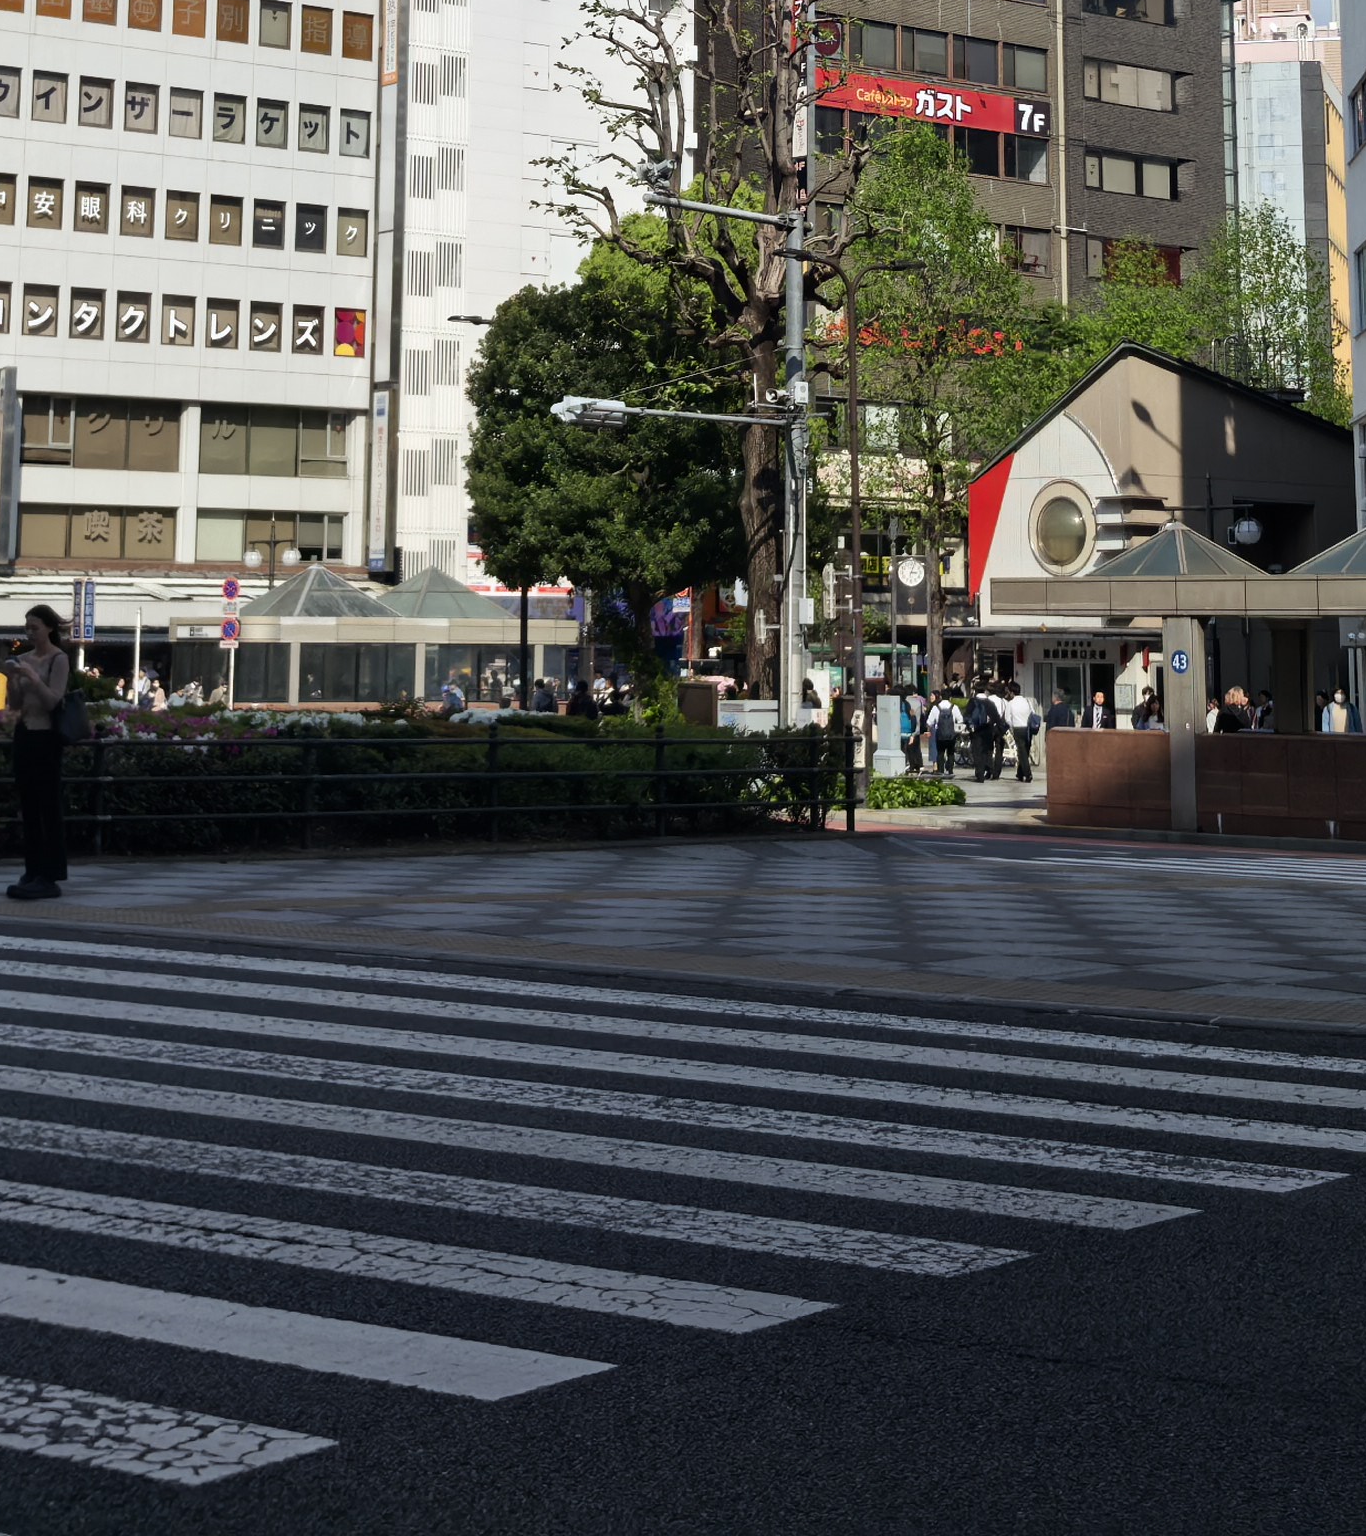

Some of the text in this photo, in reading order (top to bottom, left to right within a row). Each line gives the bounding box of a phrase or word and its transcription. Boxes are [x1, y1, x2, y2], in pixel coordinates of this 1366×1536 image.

[915, 89, 972, 122] ガスト
[1017, 103, 1045, 133] 7F
[84, 510, 163, 544] 喫茶
[1172, 654, 1187, 670] 43
